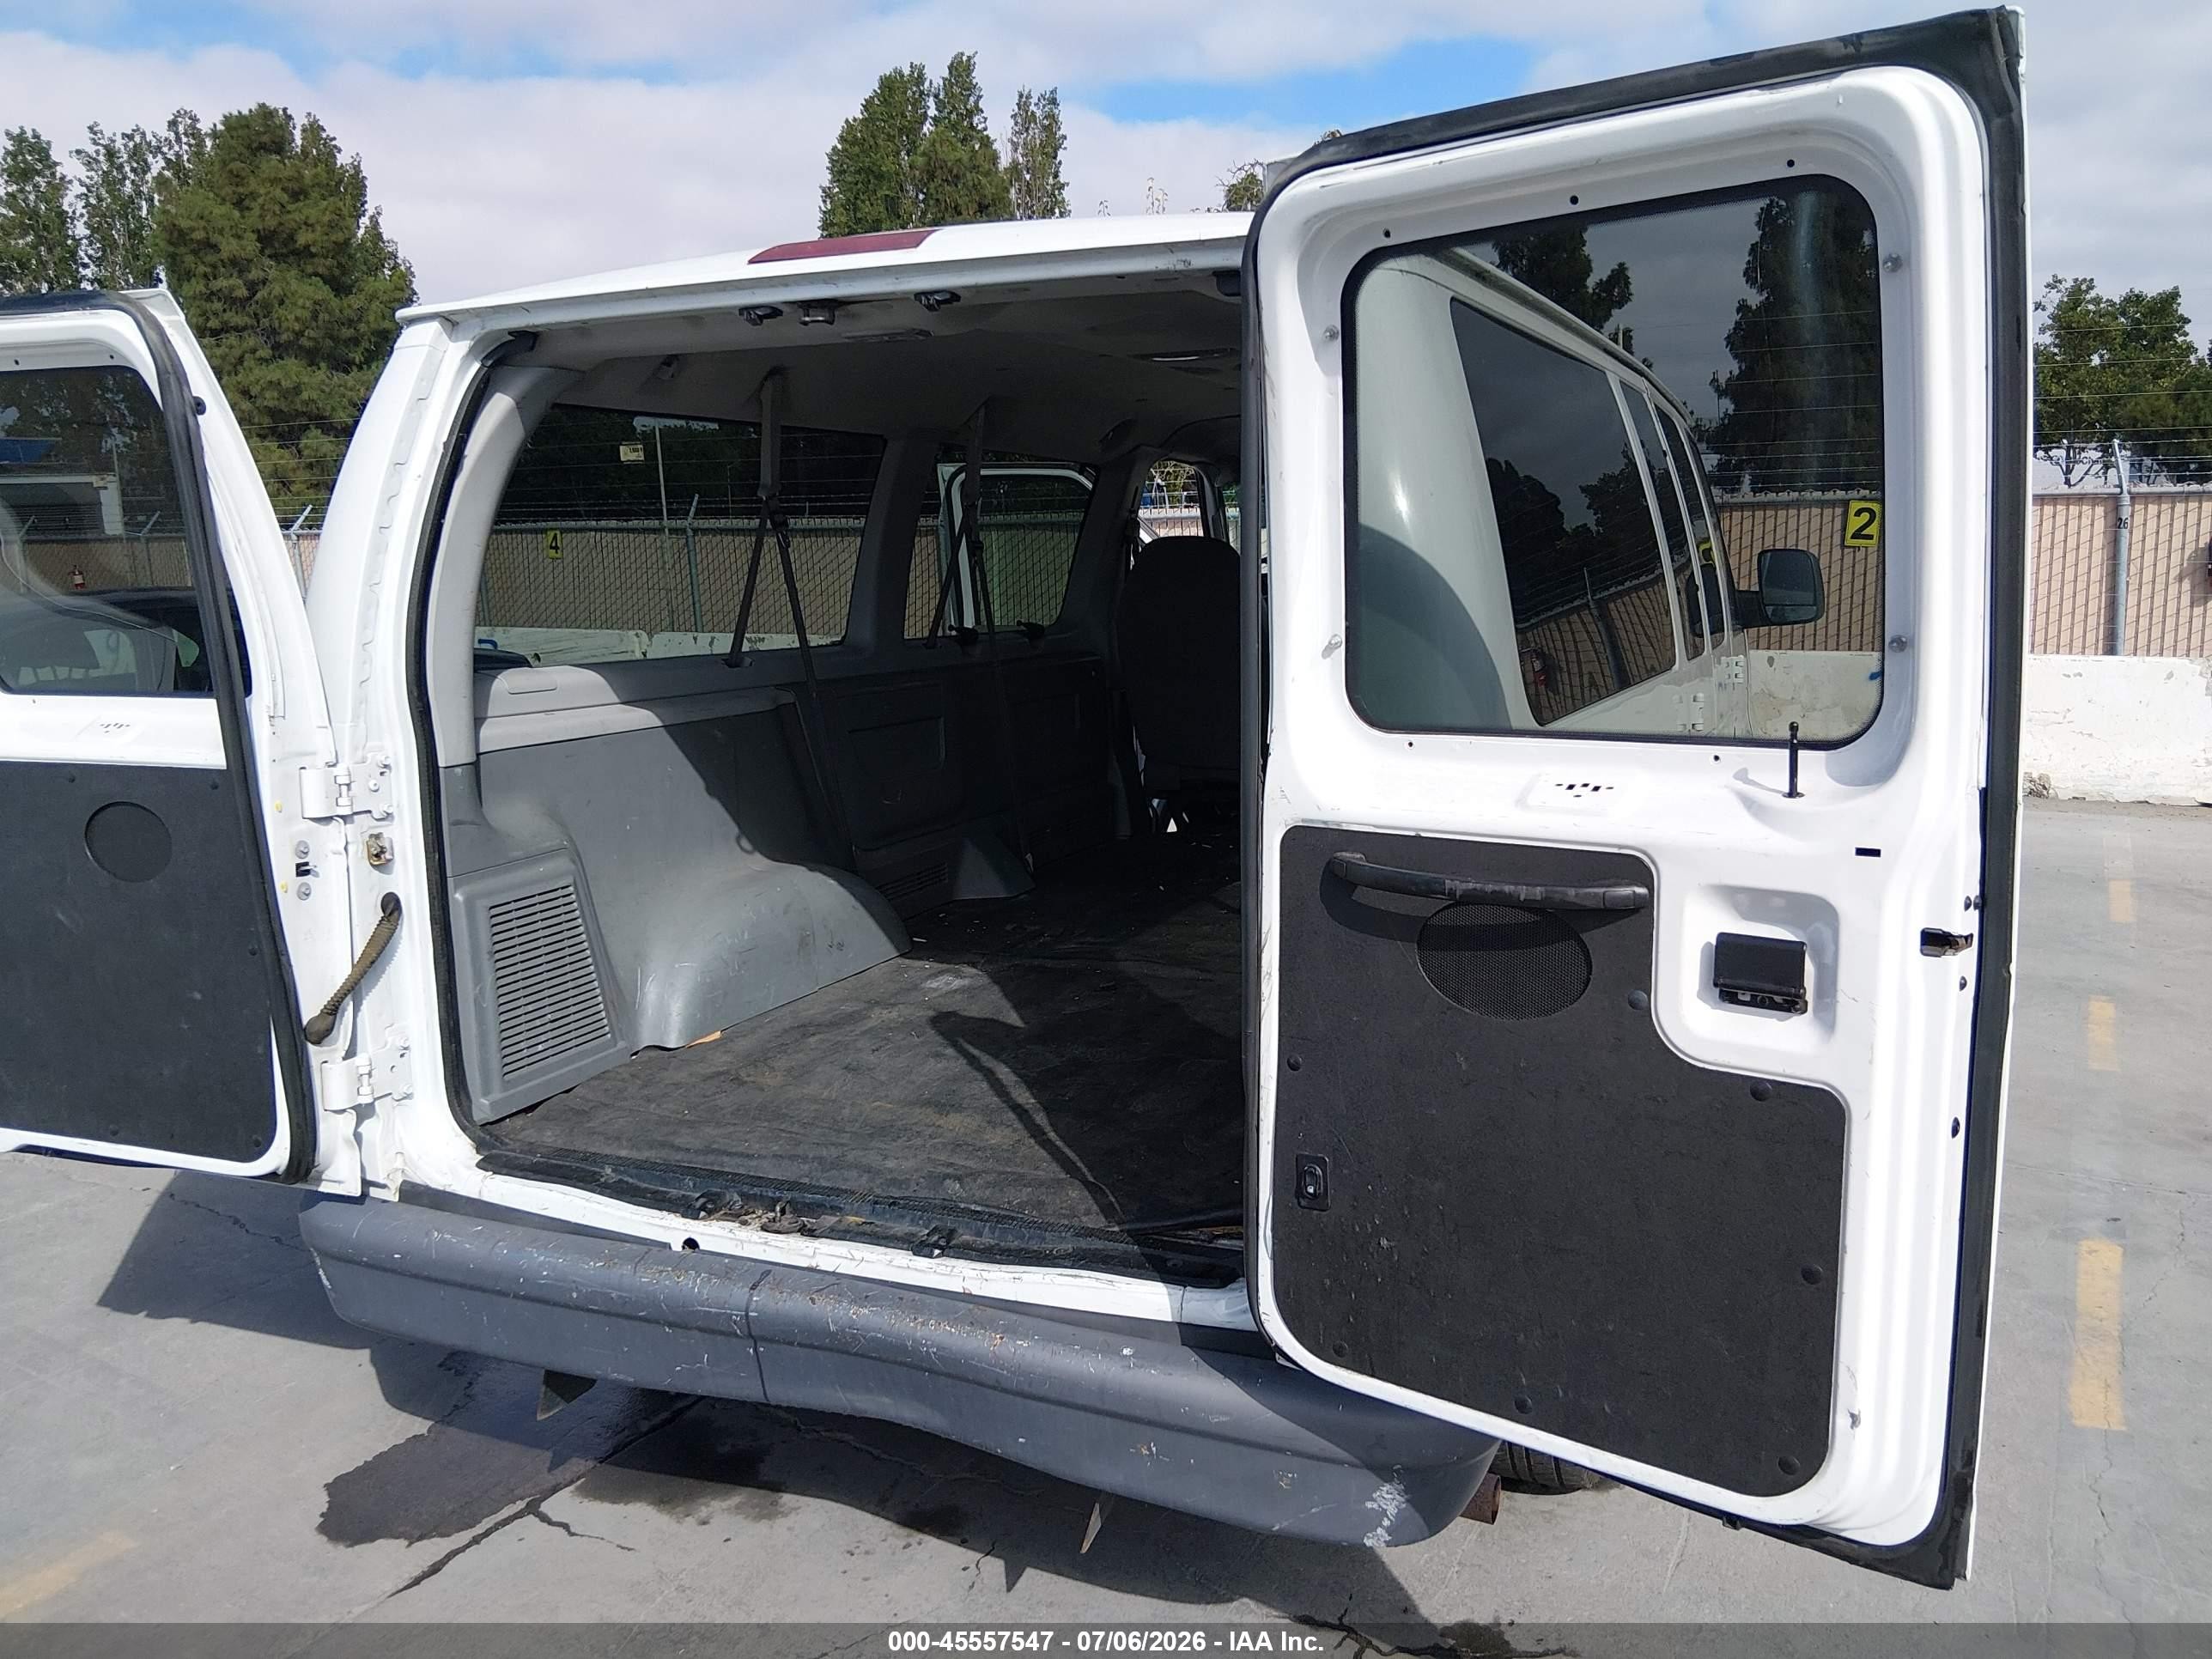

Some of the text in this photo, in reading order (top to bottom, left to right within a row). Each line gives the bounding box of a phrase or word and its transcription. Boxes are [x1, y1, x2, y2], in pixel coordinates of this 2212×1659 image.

[1850, 507, 1877, 541] 2
[2117, 517, 2129, 530] 26
[549, 532, 560, 555] 4
